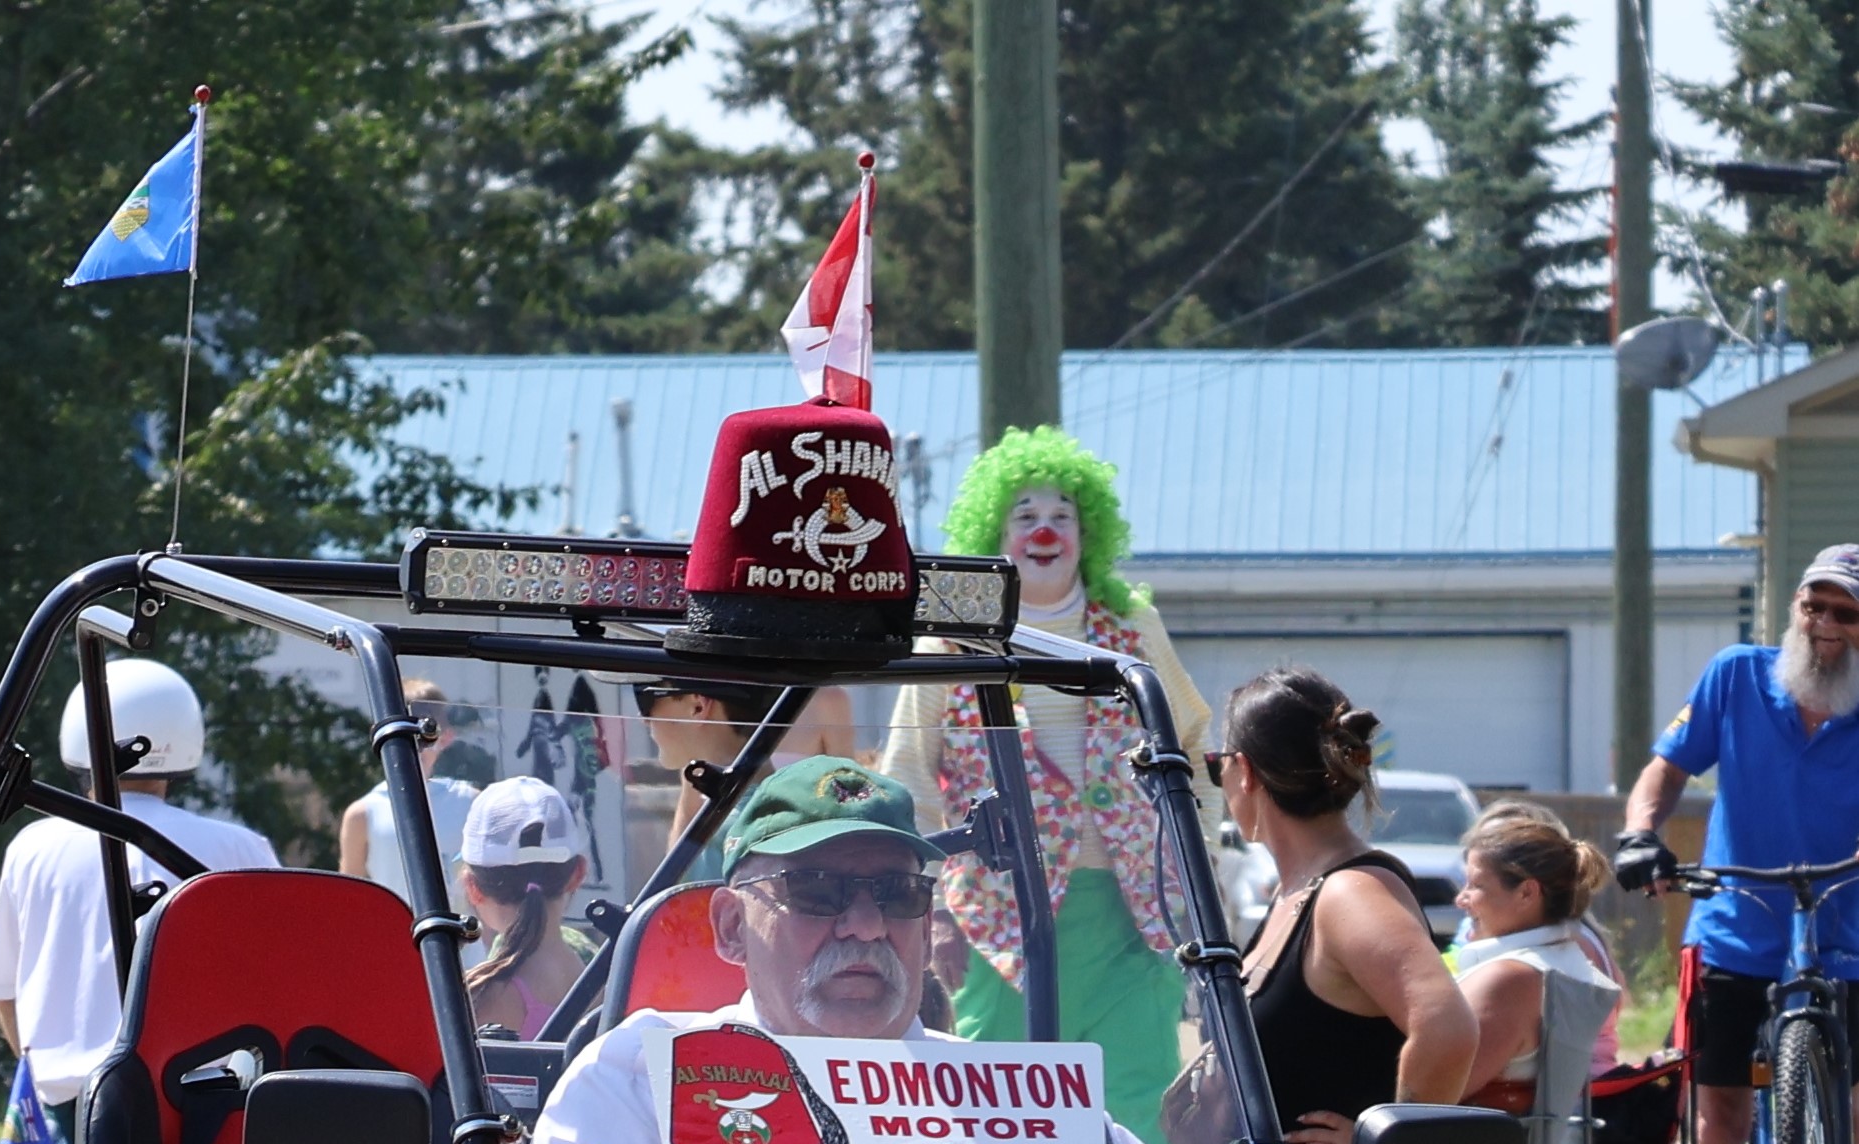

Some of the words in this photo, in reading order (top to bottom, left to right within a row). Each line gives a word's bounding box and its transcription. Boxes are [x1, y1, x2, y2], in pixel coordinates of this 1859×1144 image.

[730, 449, 788, 528] AL
[746, 565, 836, 593] MOTOR
[848, 571, 906, 594] CORPS
[675, 1065, 700, 1085] AL
[701, 1063, 793, 1092] SHAMAL
[826, 1059, 1092, 1109] EDMONTON
[869, 1115, 1059, 1139] MOTOR
